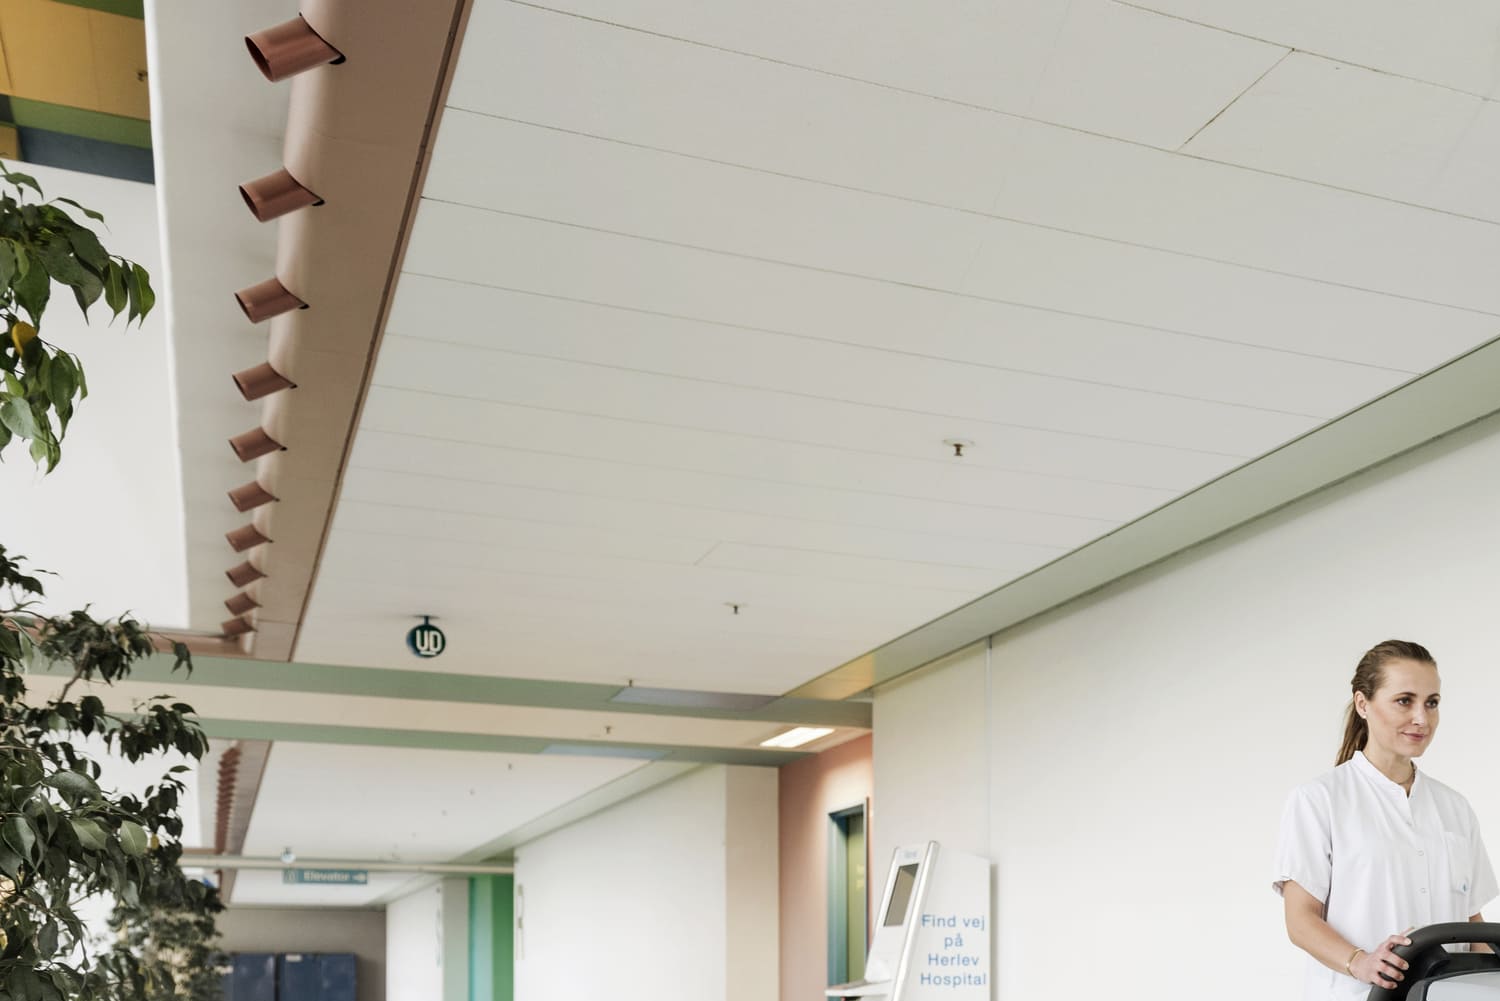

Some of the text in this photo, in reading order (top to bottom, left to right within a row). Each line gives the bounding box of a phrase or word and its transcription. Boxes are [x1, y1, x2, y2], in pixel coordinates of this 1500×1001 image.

[416, 629, 443, 653] UD
[921, 914, 985, 932] Find vej
[944, 932, 964, 950] på
[928, 953, 980, 967] Herlev
[920, 972, 986, 988] Hospital
